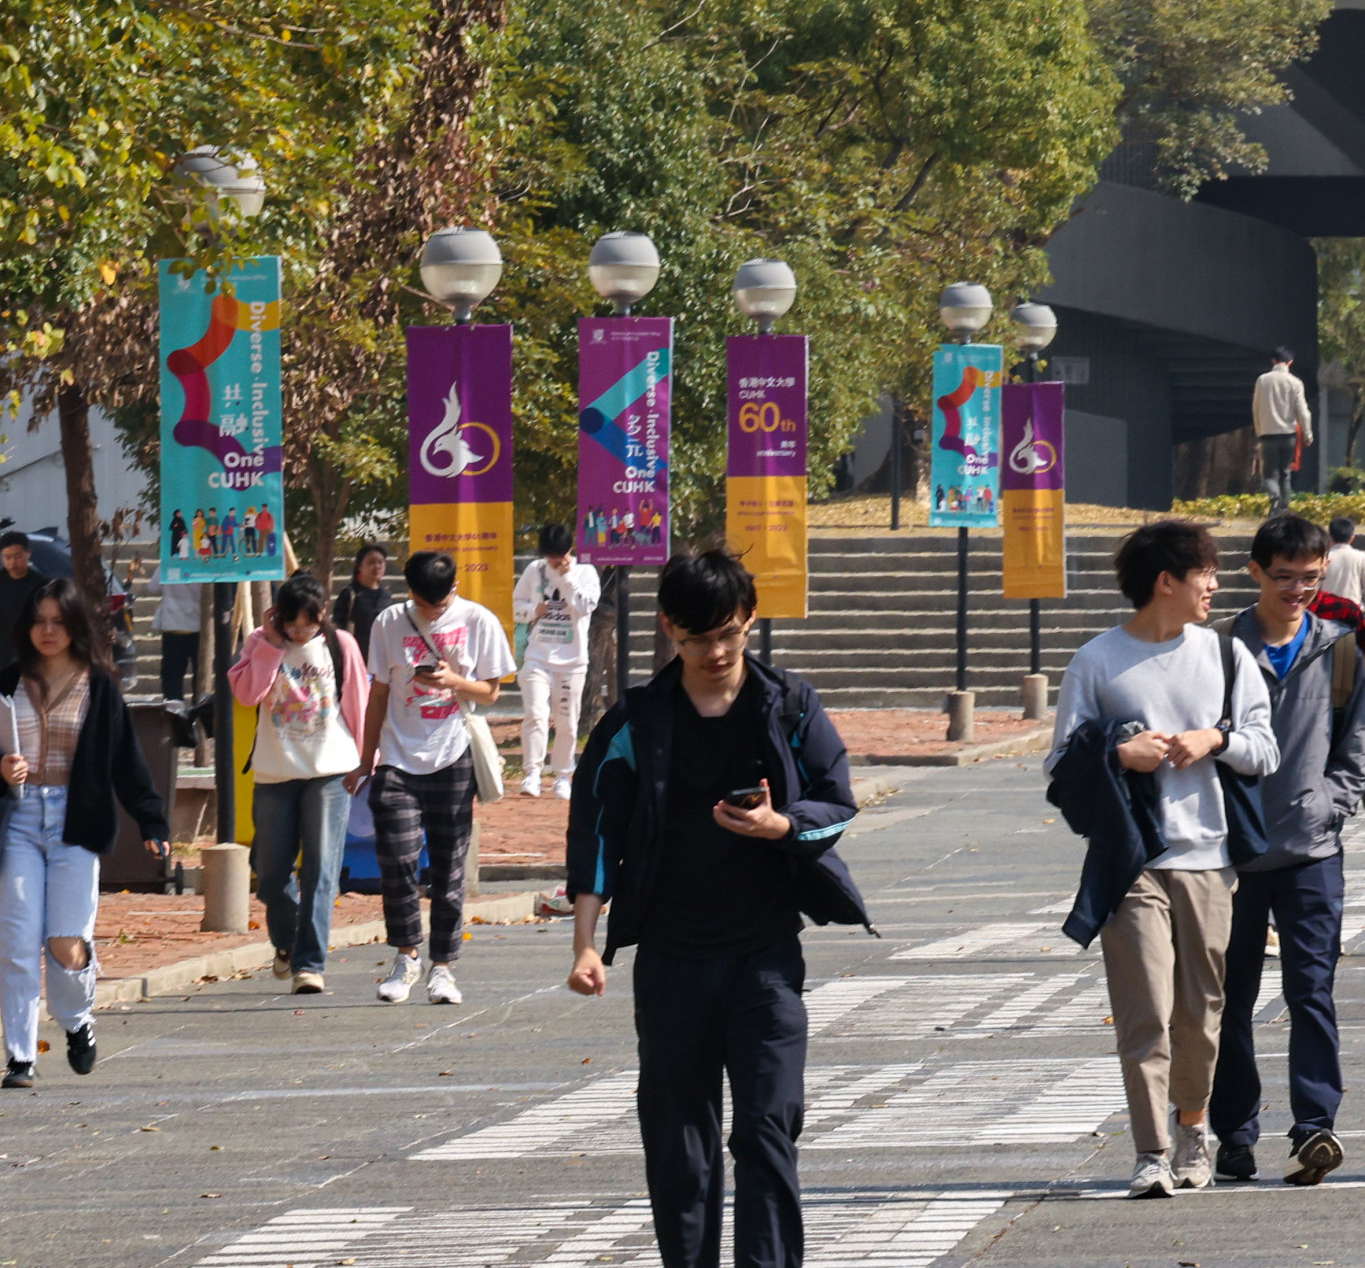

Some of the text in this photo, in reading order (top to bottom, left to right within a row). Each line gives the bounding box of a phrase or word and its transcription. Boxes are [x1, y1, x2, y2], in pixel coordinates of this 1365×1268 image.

[250, 301, 266, 374] Diverse
[646, 351, 660, 407] Diverse
[219, 383, 248, 437] 共融
[252, 383, 269, 467] Inclusive
[739, 402, 797, 433] 60th
[625, 414, 643, 457] 多元
[646, 414, 659, 478] Inclusive
[208, 471, 264, 488] CUHK
[224, 452, 264, 468] One
[625, 466, 655, 478] One
[613, 481, 656, 493] CUHK
